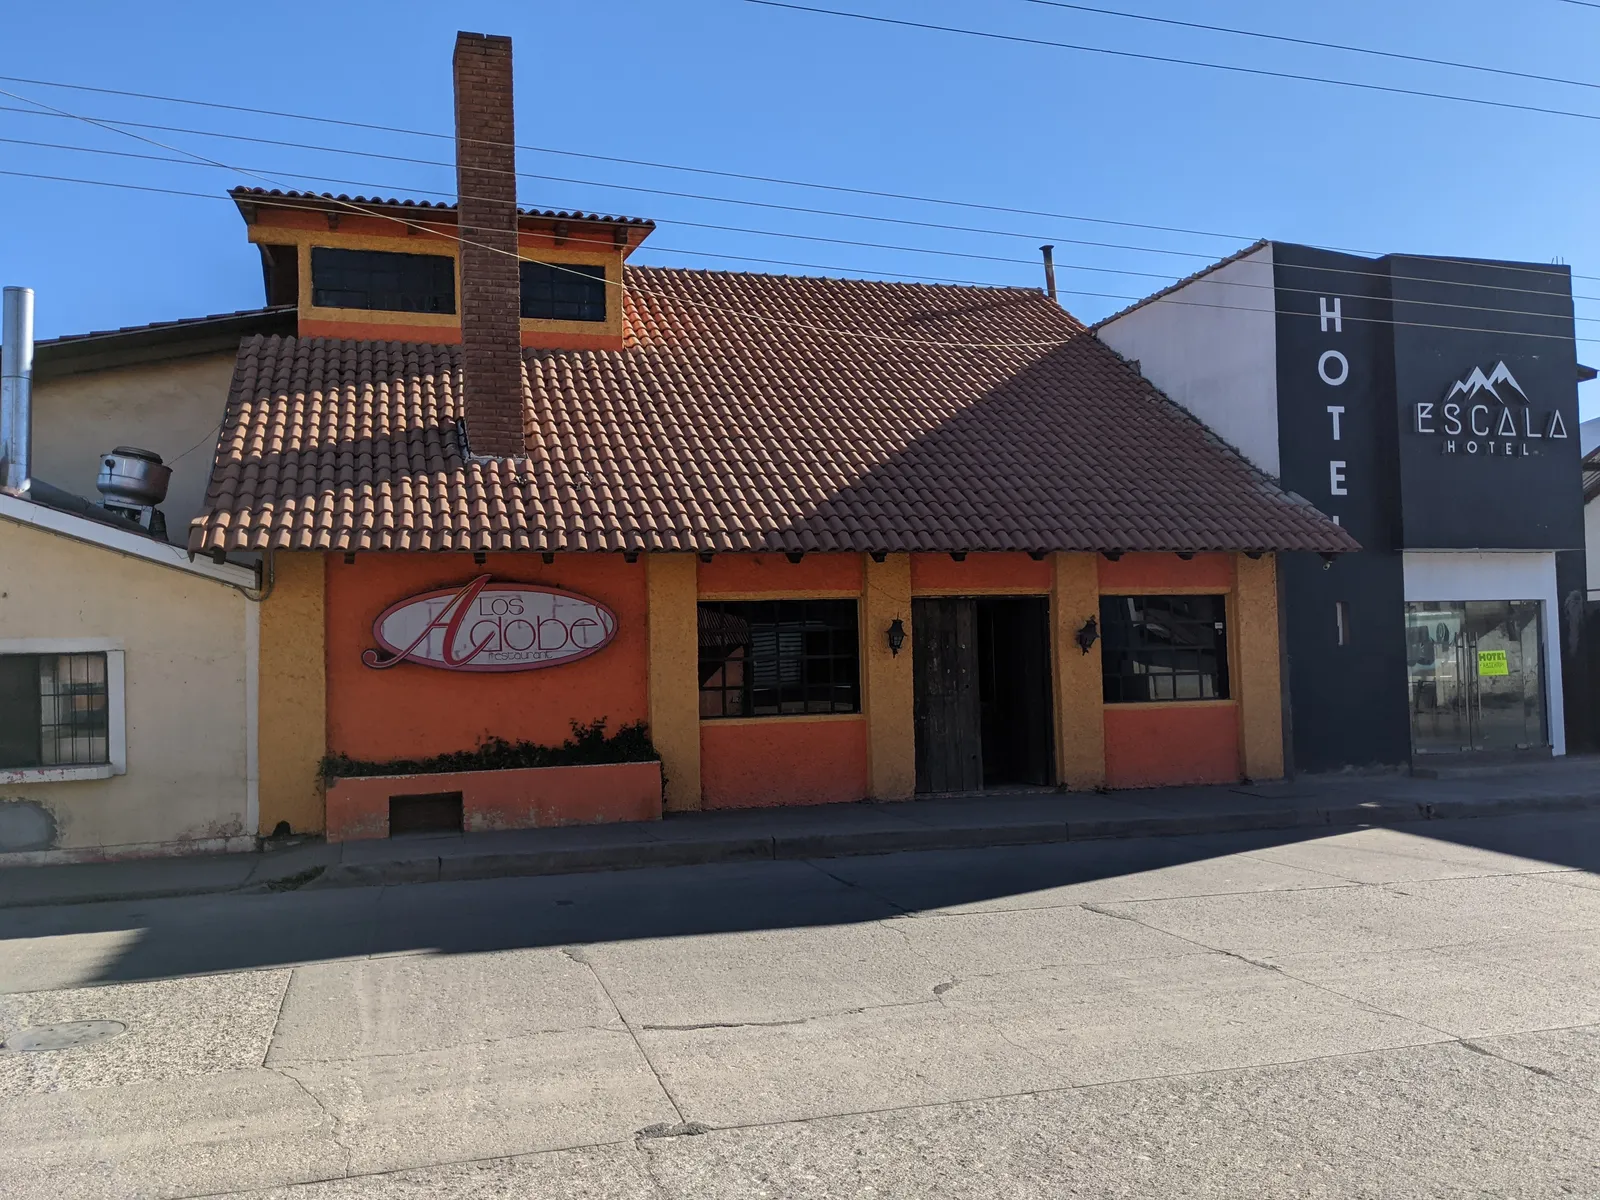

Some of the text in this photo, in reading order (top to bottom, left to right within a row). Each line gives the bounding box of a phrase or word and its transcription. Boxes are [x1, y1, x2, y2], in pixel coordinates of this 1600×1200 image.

[1417, 402, 1568, 439] ESCALA
[1447, 440, 1530, 456] HOTEL
[478, 598, 524, 616] LOS
[488, 651, 553, 661] restaurant
[1478, 652, 1506, 661] HOTEL
